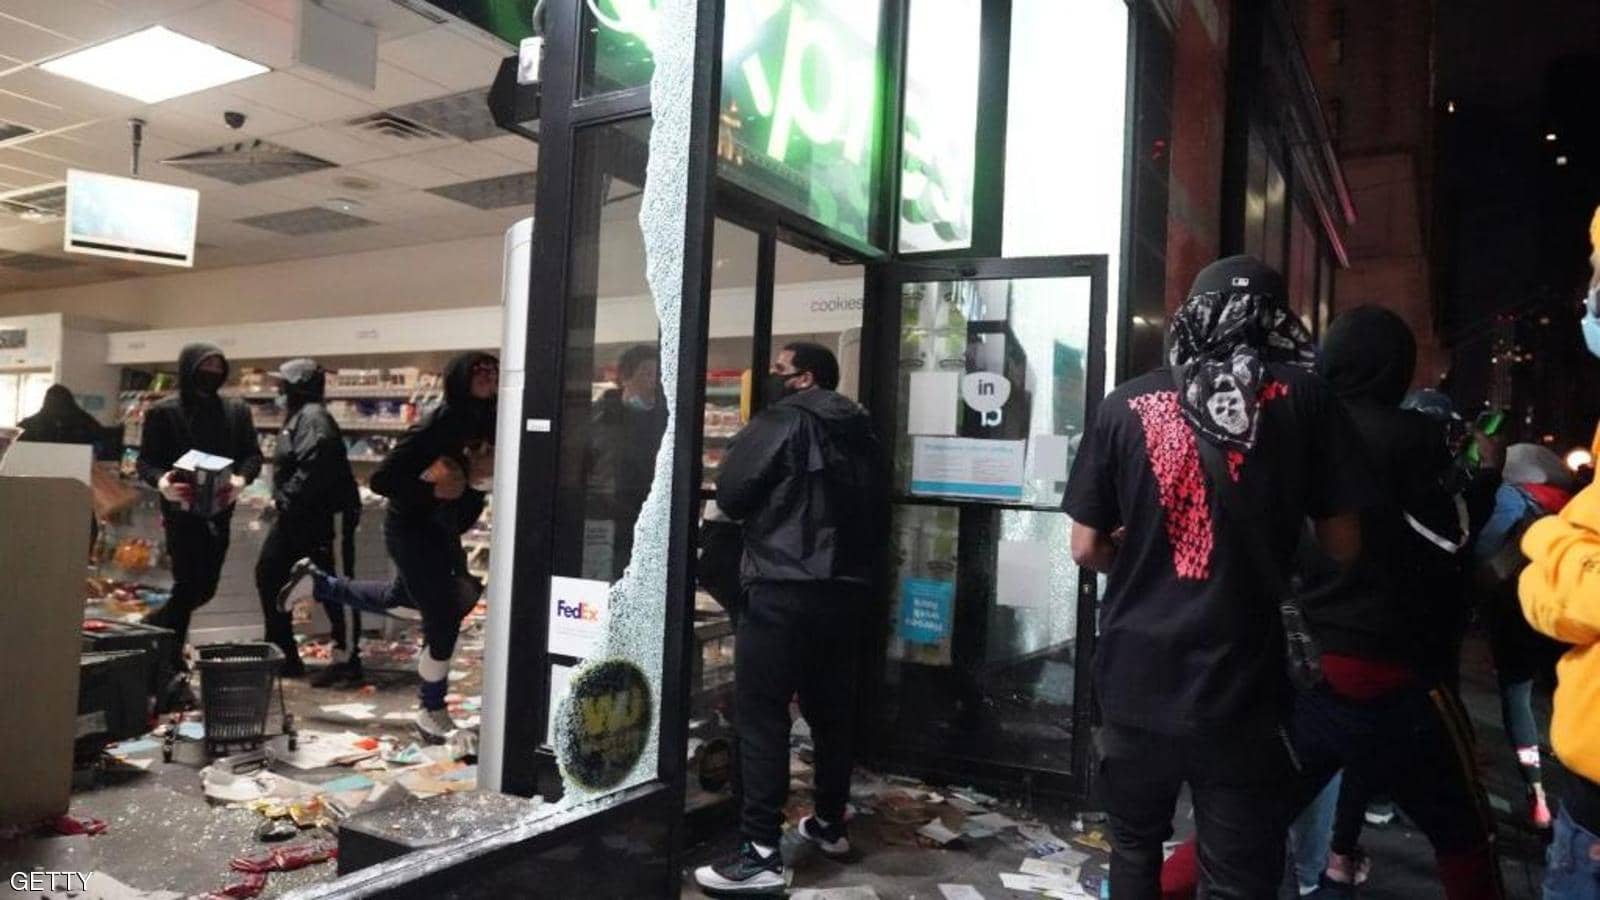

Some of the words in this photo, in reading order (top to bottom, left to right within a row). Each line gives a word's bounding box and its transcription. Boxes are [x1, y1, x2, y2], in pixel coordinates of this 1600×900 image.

[810, 296, 863, 313] cookies
[977, 379, 995, 395] in
[557, 599, 598, 622] FedEx
